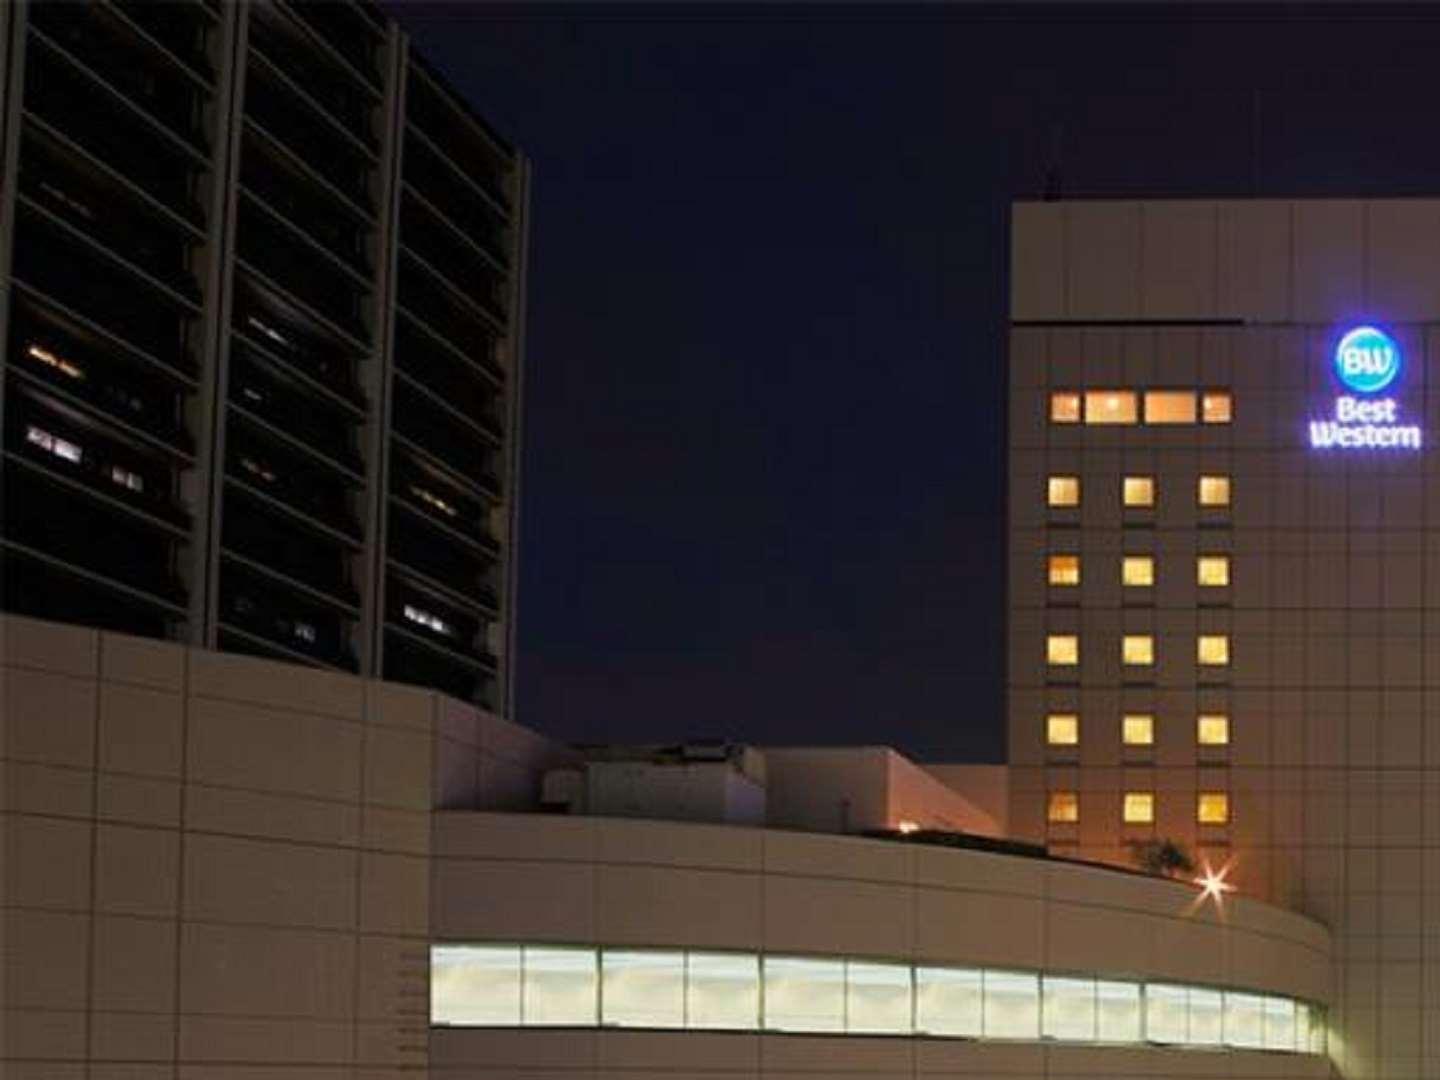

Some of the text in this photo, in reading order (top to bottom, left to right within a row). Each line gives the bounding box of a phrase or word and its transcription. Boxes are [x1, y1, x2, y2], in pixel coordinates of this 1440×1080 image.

[1343, 348, 1394, 374] BW
[1337, 397, 1396, 422] Best
[1310, 421, 1421, 449] Western
